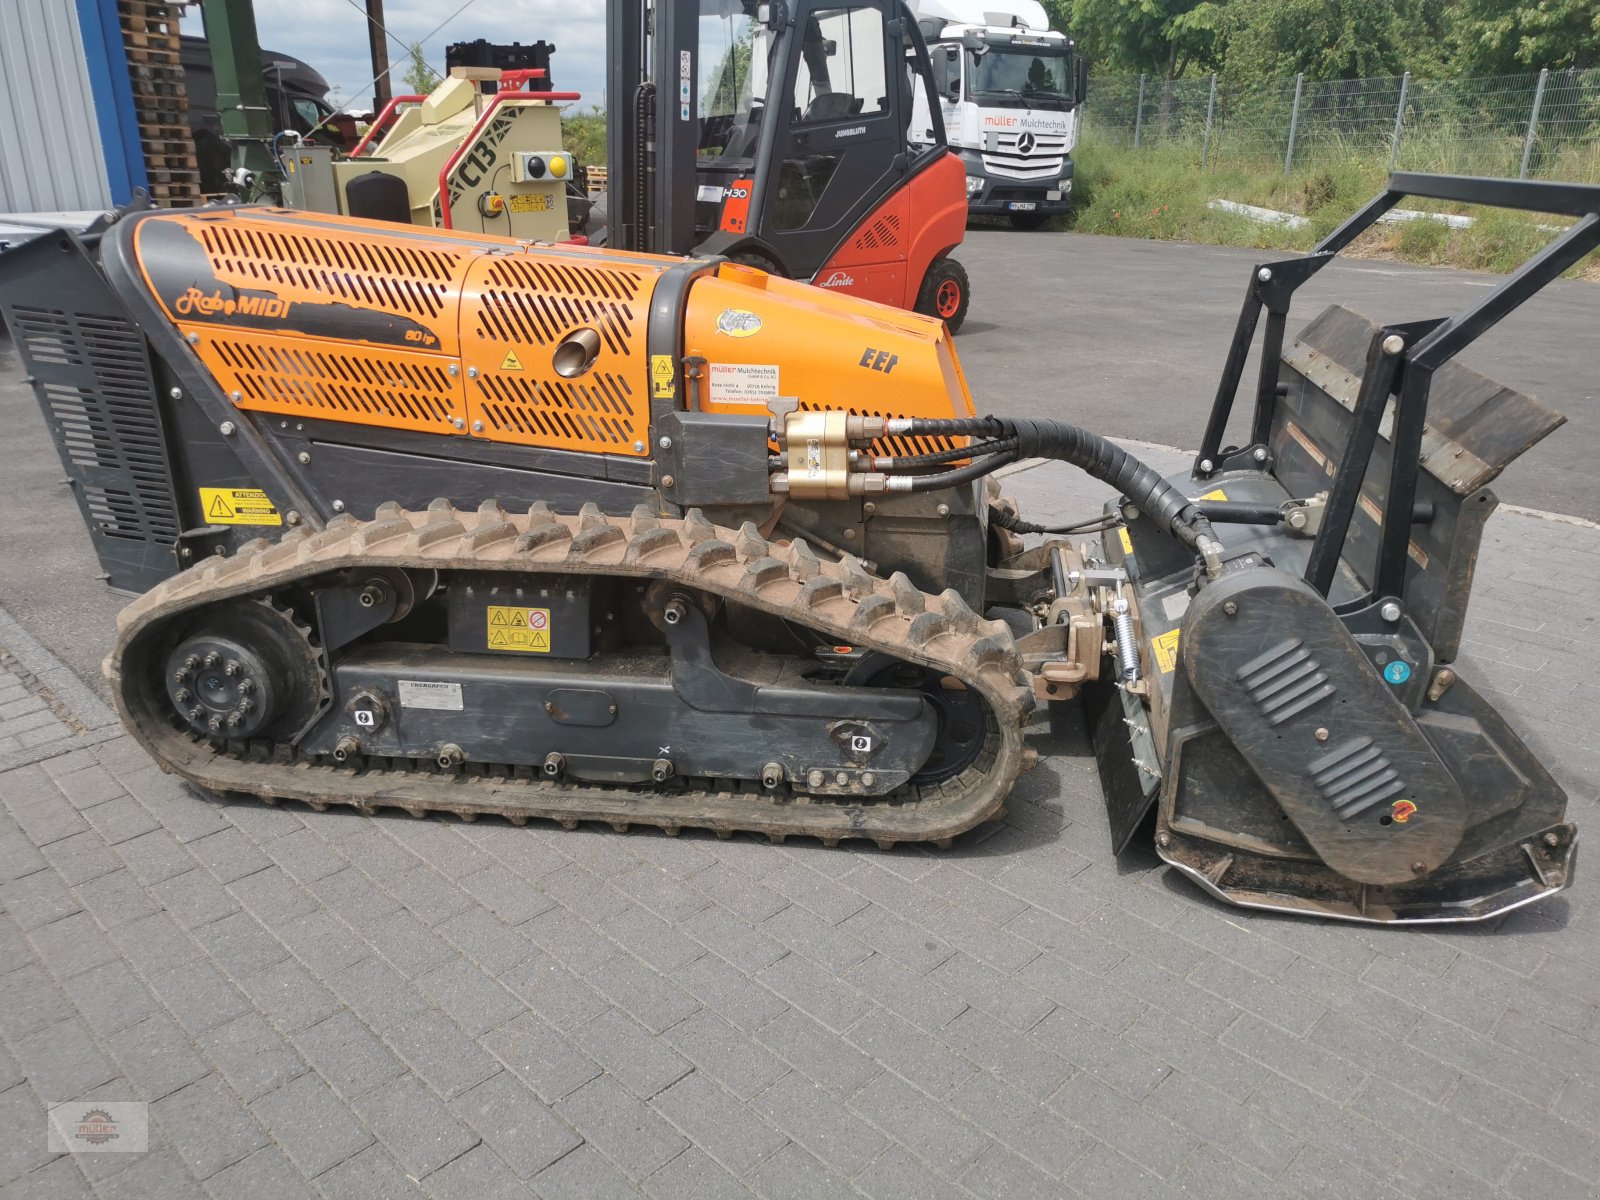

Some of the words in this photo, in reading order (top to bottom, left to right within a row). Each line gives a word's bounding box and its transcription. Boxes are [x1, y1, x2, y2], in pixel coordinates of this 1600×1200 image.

[985, 115, 1017, 127] müller
[1020, 119, 1067, 130] Mulchtechnik
[835, 126, 866, 138] JUNGBLUTH
[458, 140, 497, 188] C13
[723, 188, 747, 198] H30
[820, 271, 854, 288] Linde
[737, 367, 776, 375] Mulchtechnik
